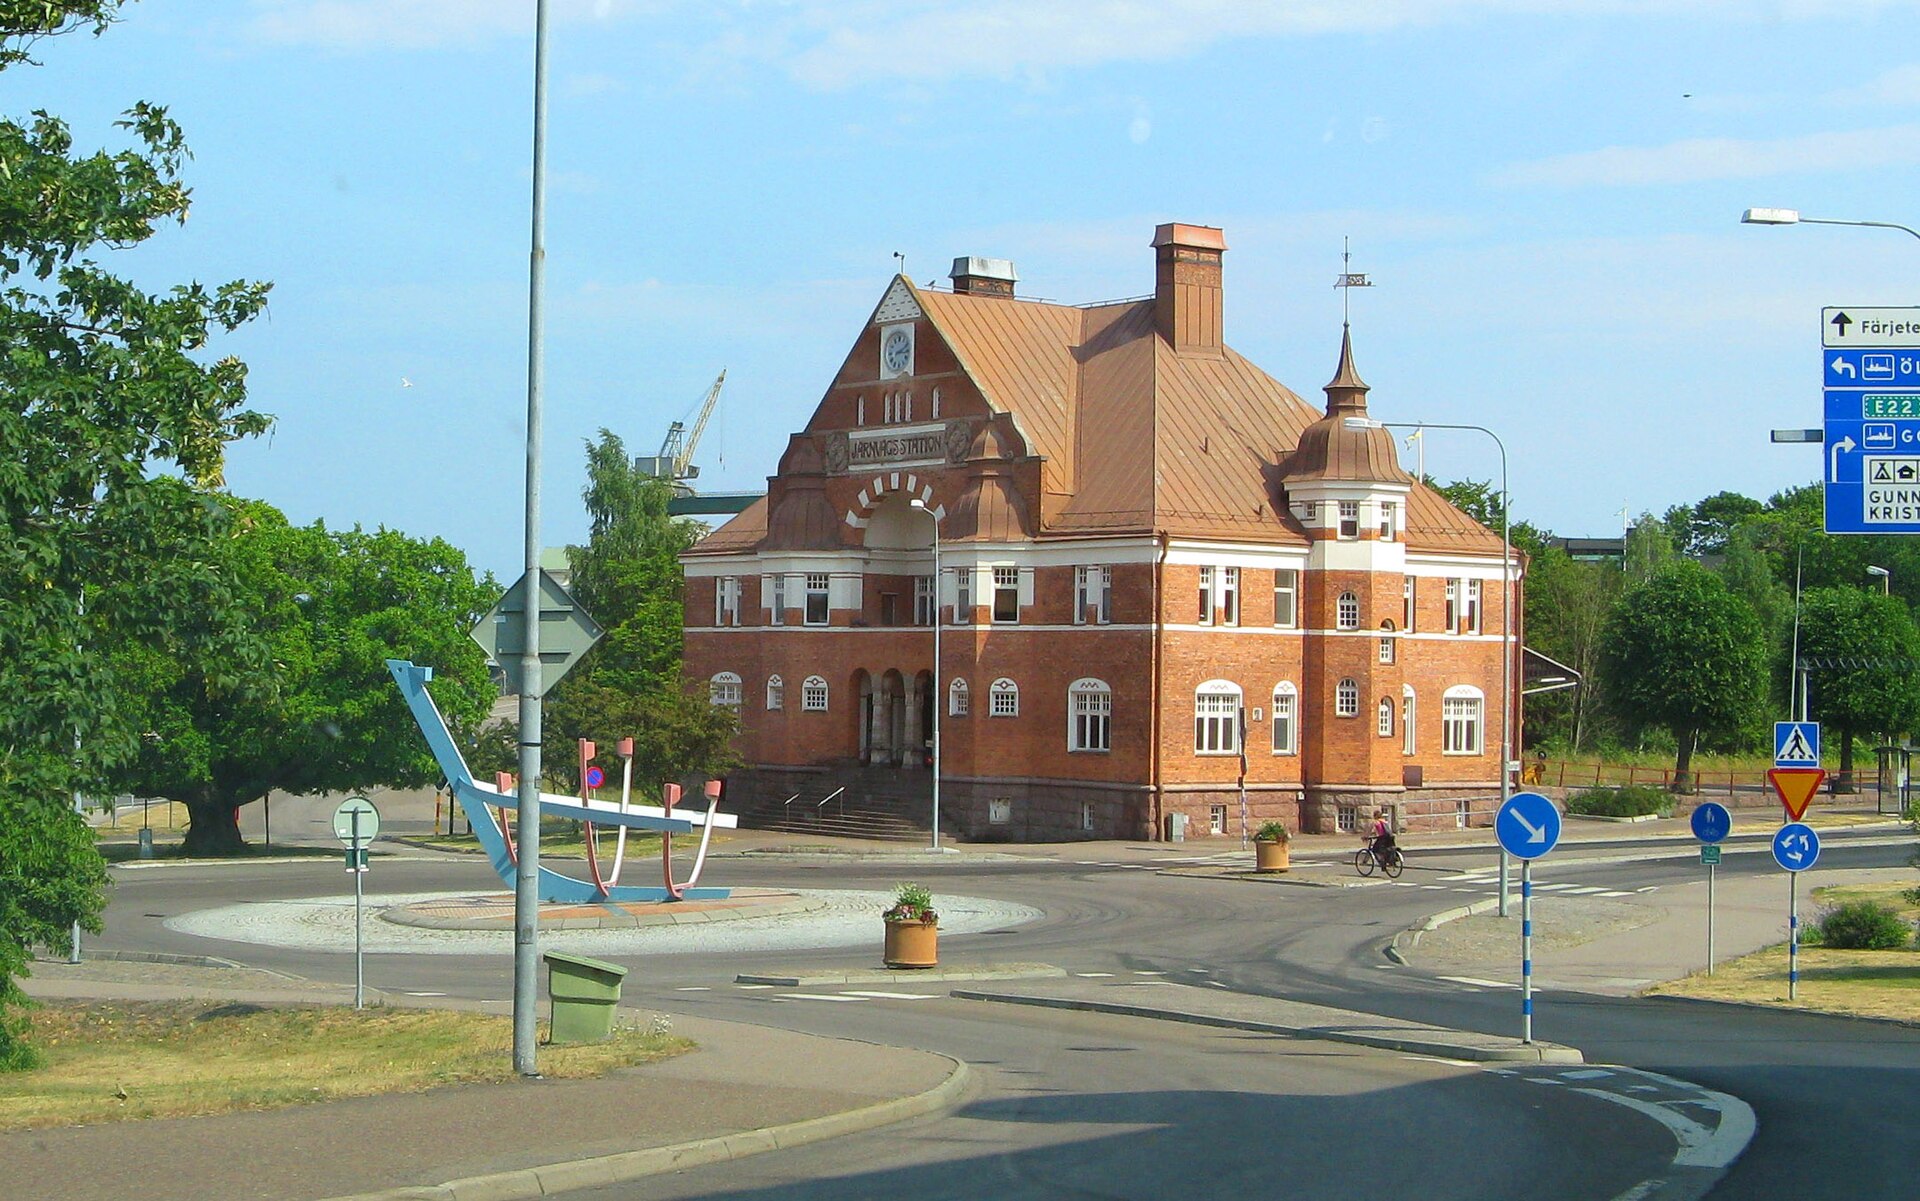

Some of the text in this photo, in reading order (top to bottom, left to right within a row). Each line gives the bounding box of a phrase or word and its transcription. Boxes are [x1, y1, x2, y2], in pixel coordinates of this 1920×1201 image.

[1862, 320, 1920, 337] Färjete
[1875, 400, 1912, 414] E22
[1901, 429, 1920, 443] G
[1869, 490, 1920, 503] GUNN
[1869, 507, 1920, 519] KRIST
